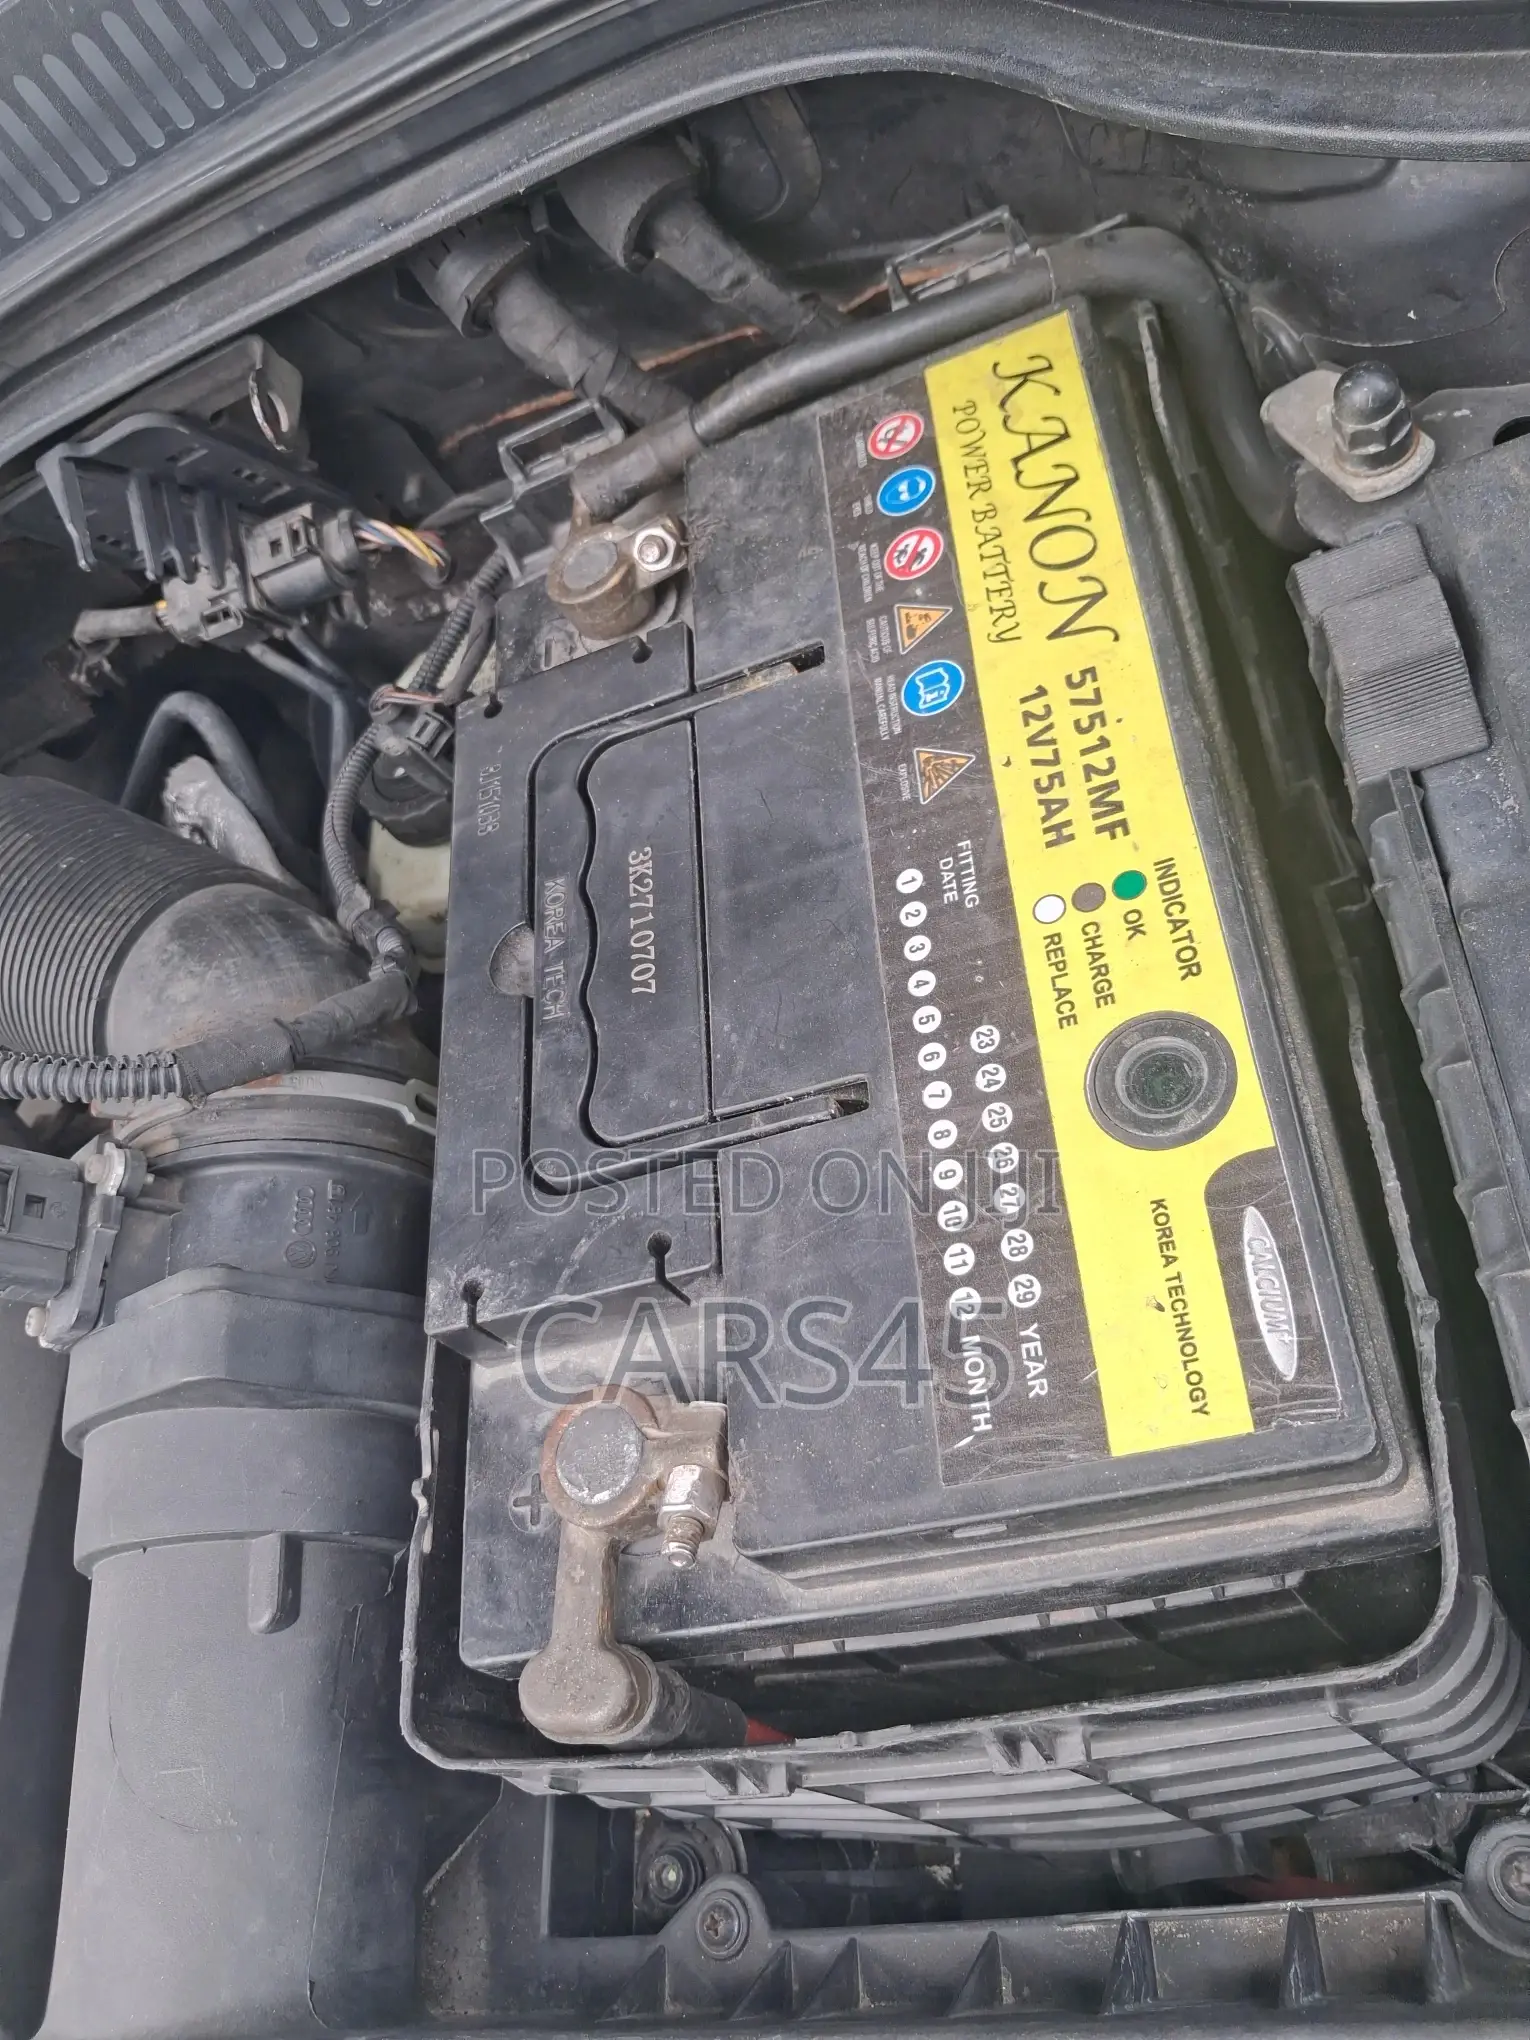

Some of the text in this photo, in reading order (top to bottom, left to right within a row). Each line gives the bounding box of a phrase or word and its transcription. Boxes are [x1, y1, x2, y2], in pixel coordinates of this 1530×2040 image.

[952, 400, 1022, 644] POWER BATTERY
[991, 354, 1120, 643] KANON
[1018, 684, 1076, 850] 12V75AH
[1065, 666, 1131, 841] 57512MF
[628, 846, 656, 995] 3K2710707
[939, 857, 959, 904] DATE
[957, 840, 980, 909] FITTING
[1122, 909, 1147, 941] OK
[1153, 857, 1203, 982] INDICATOR
[543, 876, 569, 1021] KOREA TECH
[1043, 932, 1079, 1030] REPLACE
[1081, 921, 1117, 1009] CHARGE
[943, 1205, 964, 1228] 10
[949, 1248, 970, 1269] 11
[975, 1028, 1049, 1399] 23 24 25 26 27 28 29 YEAR
[955, 1292, 976, 1317] 12
[1150, 1198, 1211, 1417] KOREA TECHNOLOGY
[960, 1335, 993, 1432] MONTH
